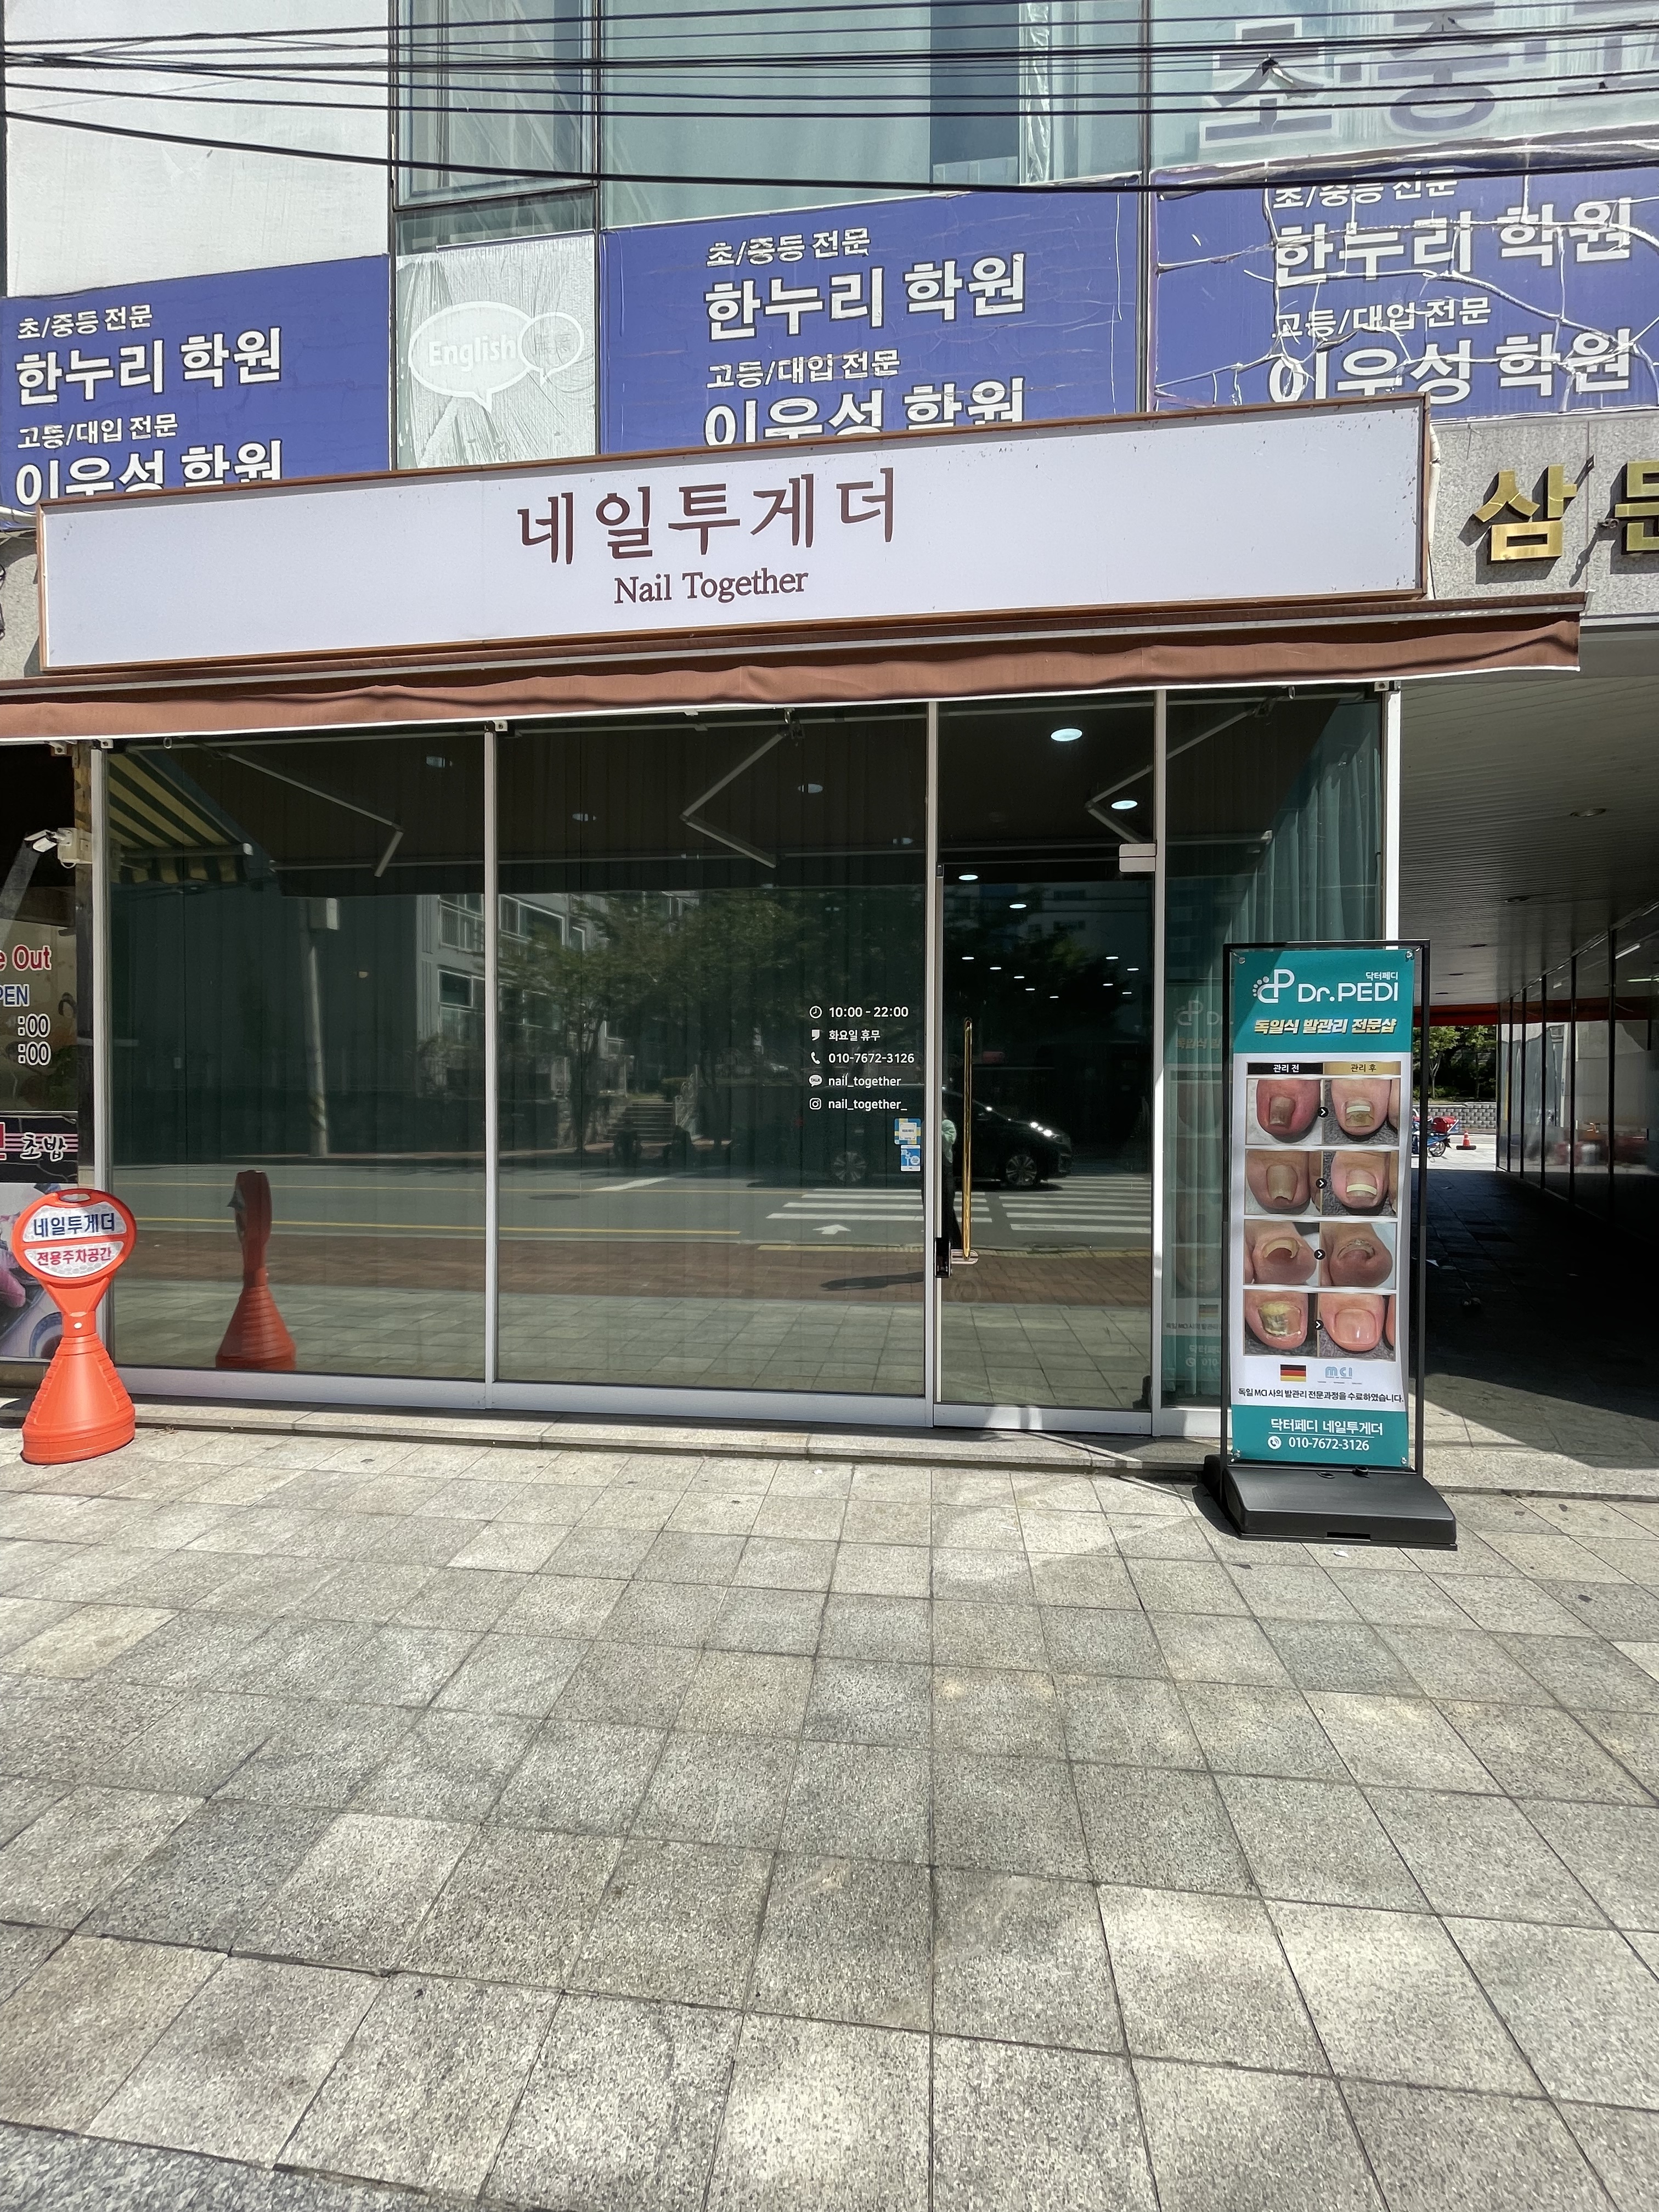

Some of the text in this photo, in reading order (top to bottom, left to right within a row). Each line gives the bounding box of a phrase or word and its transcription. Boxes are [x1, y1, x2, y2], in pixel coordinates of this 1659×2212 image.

[706, 227, 871, 267] 초/중등 전문
[1276, 200, 1631, 289] 한누리 학원
[704, 253, 1025, 341] 한누리 학원
[18, 303, 153, 340] 초/중등 전문
[1271, 297, 1492, 338] 고등/대입 전문
[16, 327, 281, 405] 한누리 학원
[428, 334, 517, 373] English
[1269, 328, 1631, 405] 이우성 학원
[707, 349, 901, 389] 고등/대입 전문
[704, 377, 1025, 447] 이우성 학원
[17, 413, 178, 450] 고등/대입 전문
[15, 439, 282, 506] 이우성 학원
[516, 467, 895, 565] 네일투게더
[614, 567, 809, 604] Nail Together
[13, 944, 52, 971] Out
[1365, 972, 1399, 981] 닥터페디
[1298, 982, 1398, 1002] Dr.PEDI
[829, 1007, 863, 1018] 10:00
[873, 1006, 909, 1017] 22:00
[828, 1029, 881, 1041] 화요일 휴무
[1254, 1018, 1397, 1035] 독일식 발관리 전문샵
[828, 1053, 915, 1064] 010-7672-3126
[1273, 1064, 1300, 1073] 관리 전
[1350, 1063, 1376, 1073] 관리 후
[828, 1075, 902, 1088] nail_together
[828, 1098, 908, 1111] nail_together_
[20, 1132, 68, 1162] 초밥
[33, 1212, 115, 1238] 네일투게더
[37, 1248, 112, 1266] 전용주차공간
[1238, 1388, 1254, 1397] 독일
[1269, 1389, 1284, 1398] 사의
[1285, 1390, 1307, 1399] 발관리
[1308, 1391, 1347, 1401] 전문과정을
[1347, 1393, 1404, 1403] 수료하였습니다.
[1271, 1418, 1384, 1436] 닥터페디 네일투게더
[1289, 1437, 1370, 1451] 010-7672-3126
